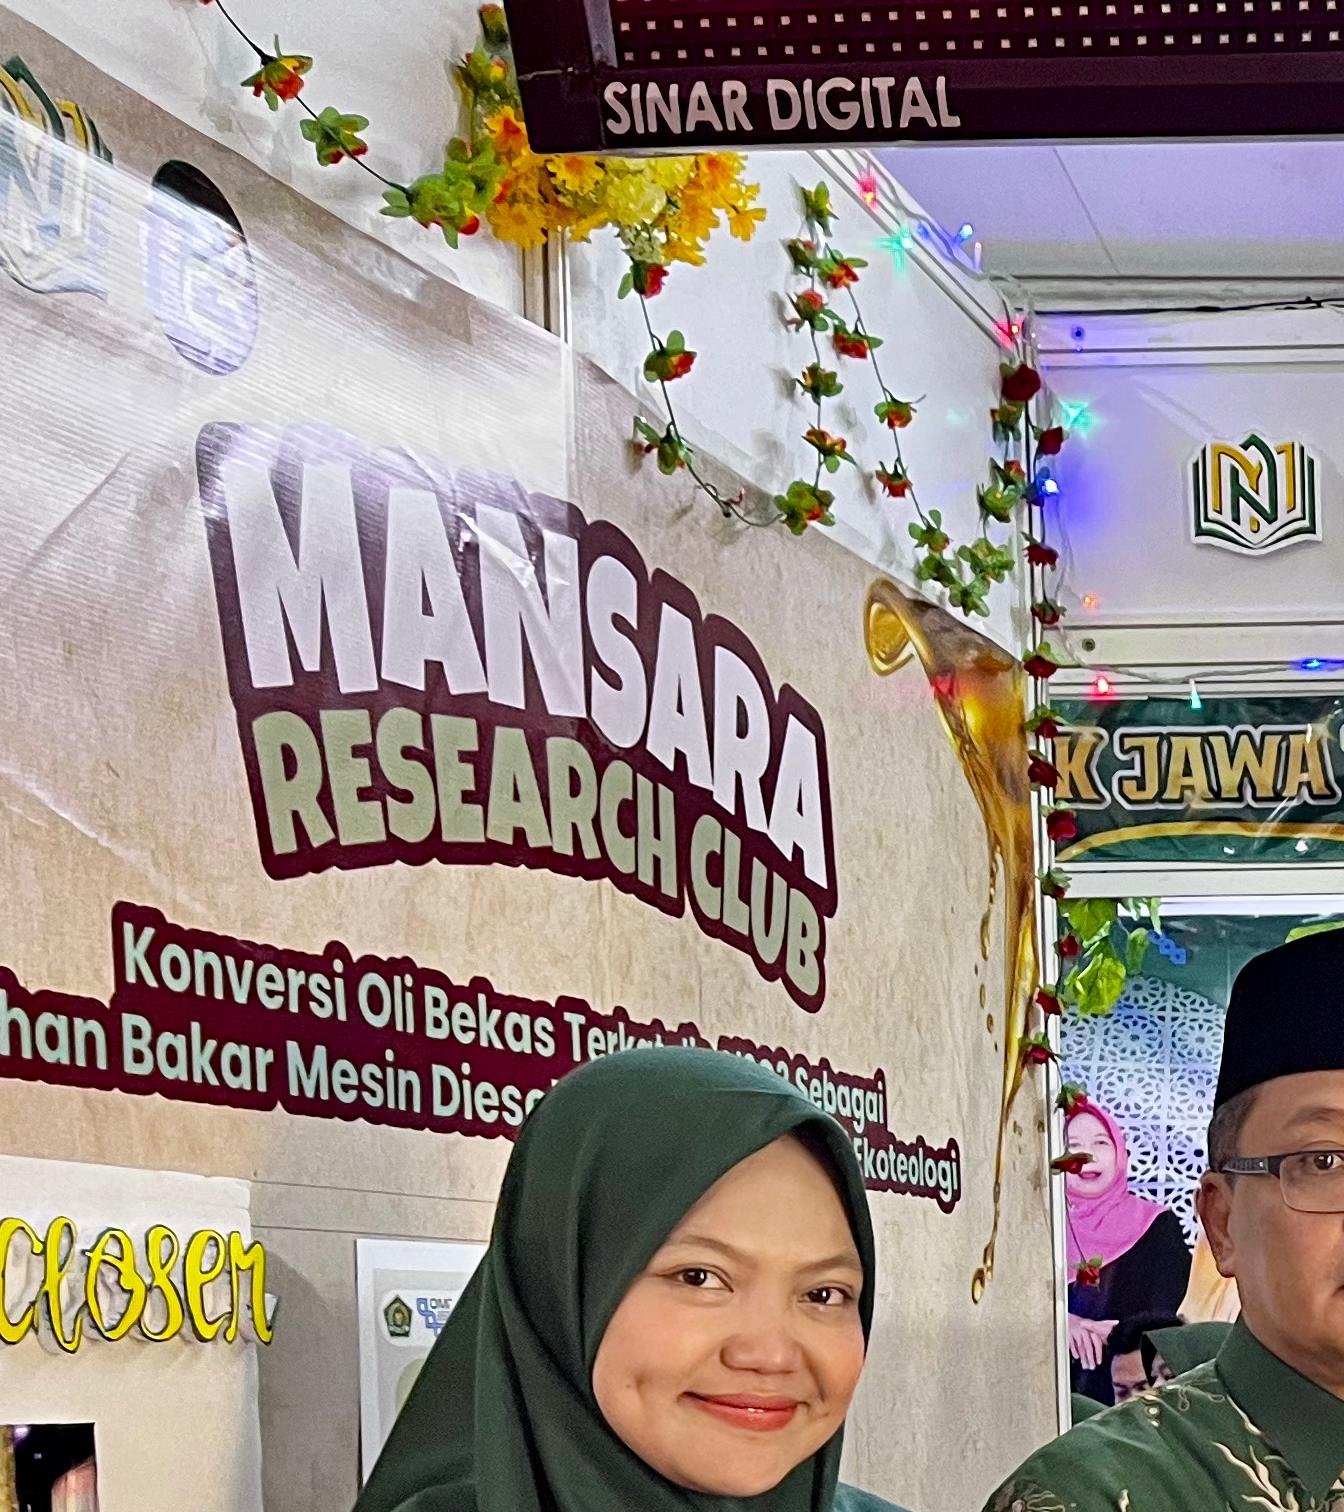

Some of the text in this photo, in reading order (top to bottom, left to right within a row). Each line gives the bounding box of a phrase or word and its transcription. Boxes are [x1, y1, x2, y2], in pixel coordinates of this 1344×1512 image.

[605, 76, 961, 135] SINAR DIGITAL
[223, 458, 829, 890] MANSARA
[1121, 729, 1337, 802] JAWA
[252, 707, 821, 998] RESEARCH CLUB
[122, 922, 347, 1021] Konversi
[357, 972, 415, 1034] Oli
[424, 984, 556, 1057] Bekas
[795, 1066, 886, 1134] Sebagai
[122, 1015, 273, 1092] Bakar
[287, 1043, 422, 1115] Mesin
